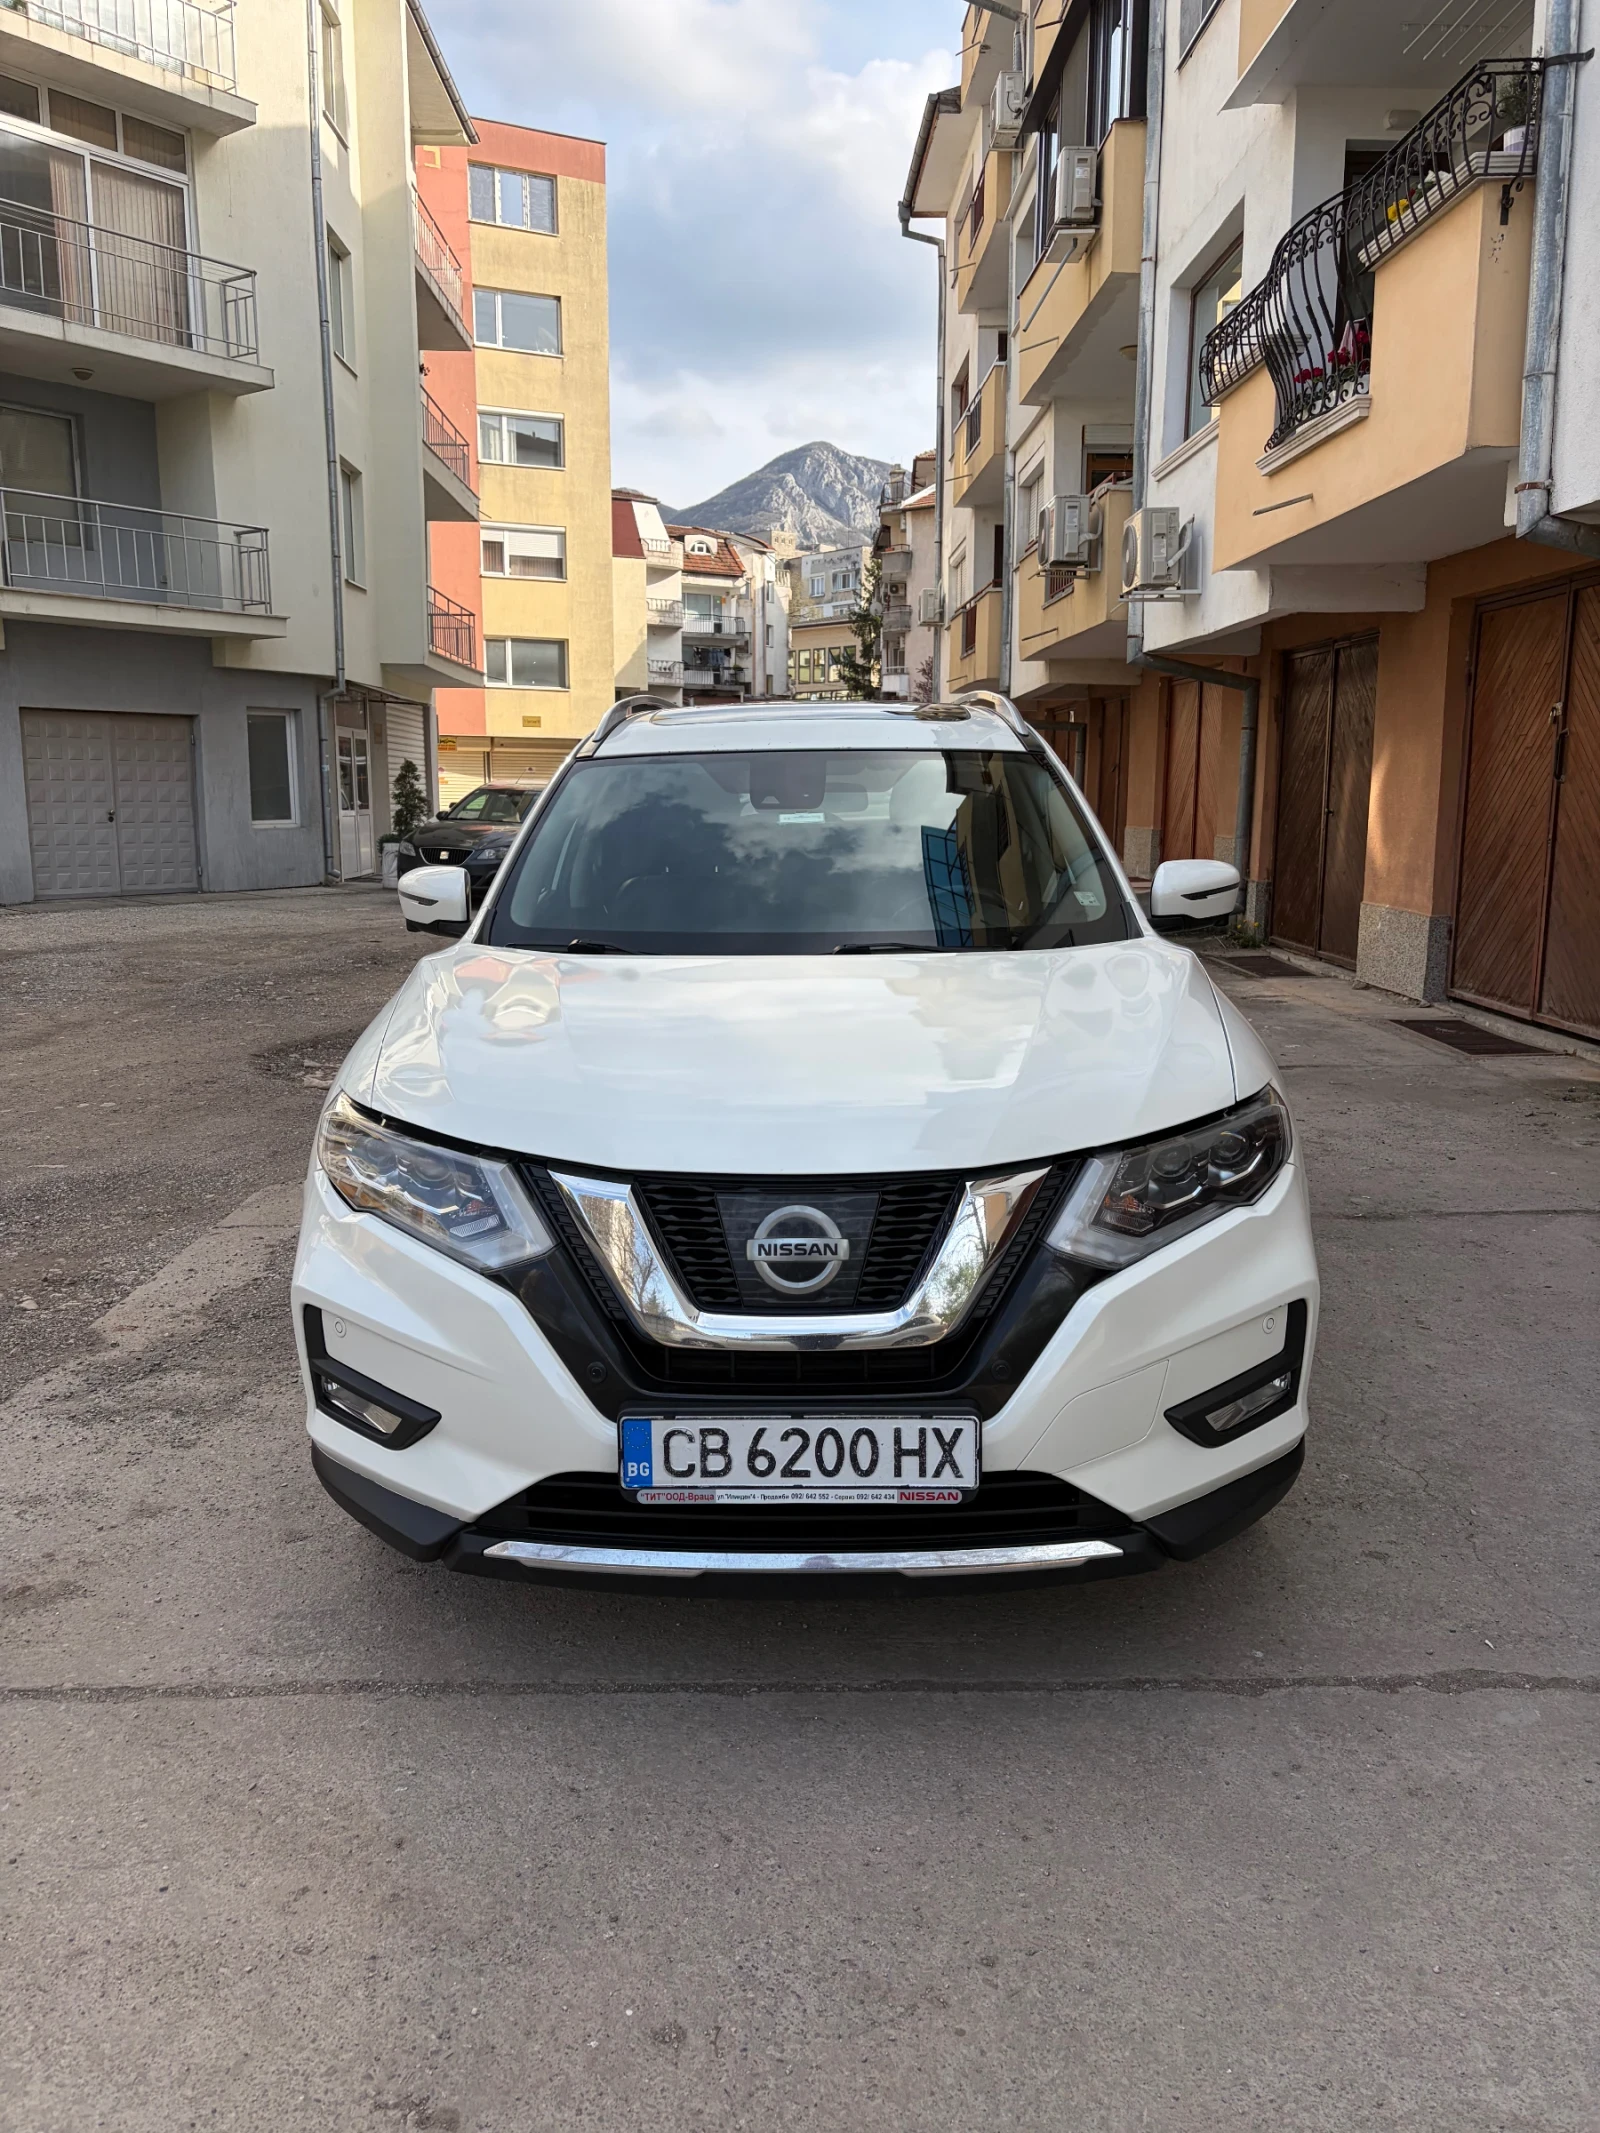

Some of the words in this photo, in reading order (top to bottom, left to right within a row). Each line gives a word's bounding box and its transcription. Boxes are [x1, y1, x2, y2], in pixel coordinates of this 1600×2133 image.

[757, 1243, 838, 1257] NISSAN
[663, 1427, 733, 1478] CB
[747, 1427, 879, 1478] 6200
[893, 1427, 964, 1478] HX
[627, 1462, 650, 1477] BG
[805, 1492, 817, 1500] 642
[900, 1491, 959, 1501] NISSAN
